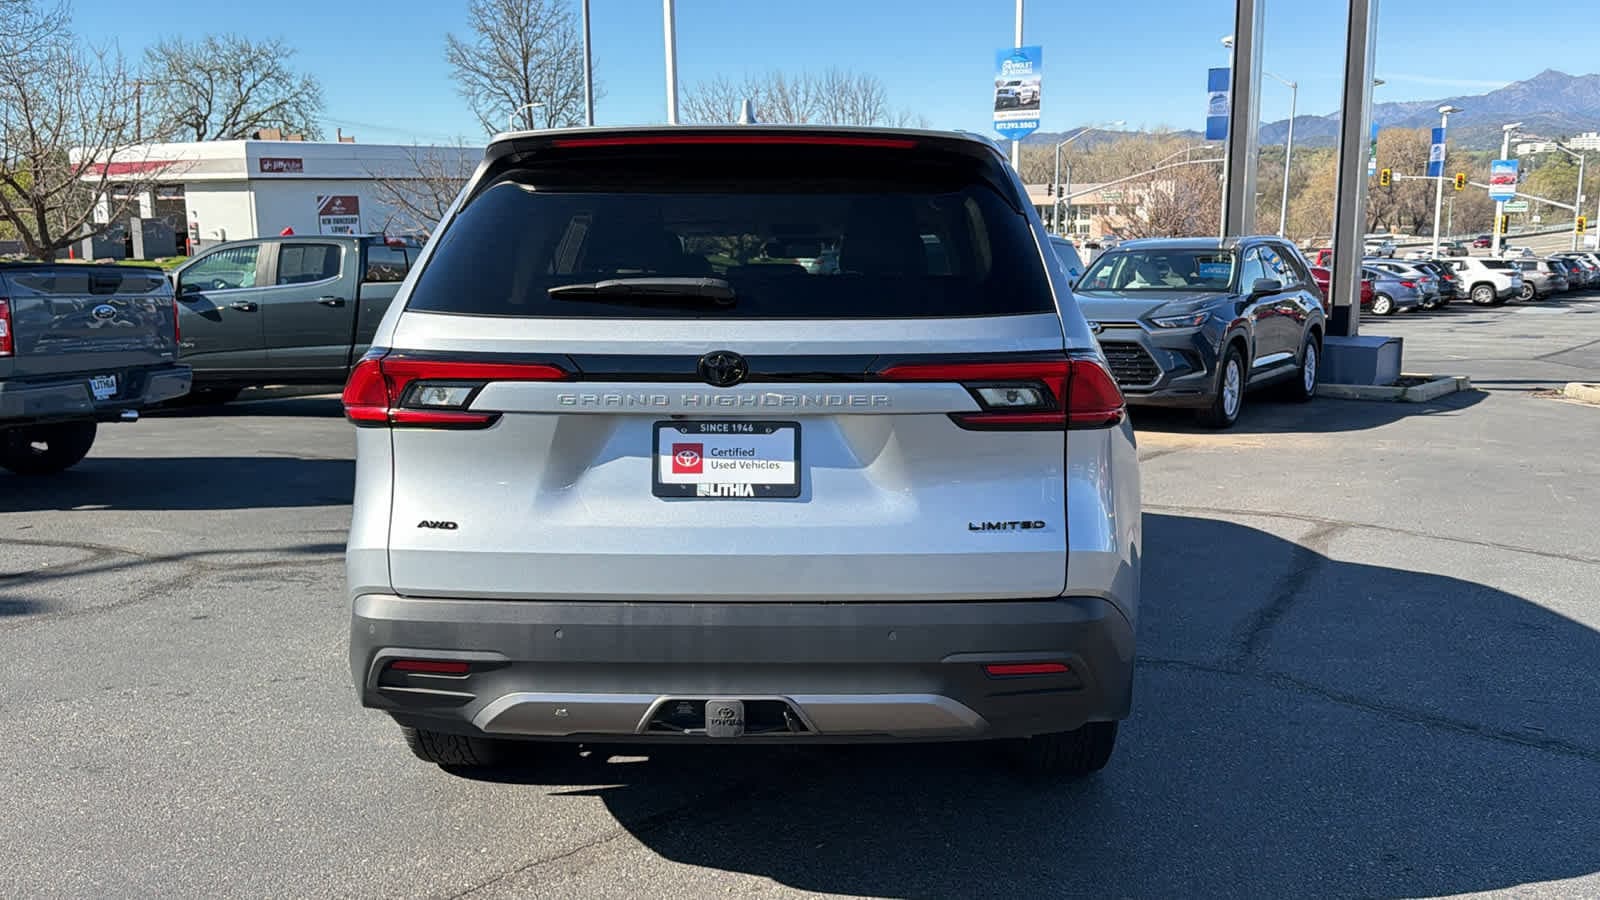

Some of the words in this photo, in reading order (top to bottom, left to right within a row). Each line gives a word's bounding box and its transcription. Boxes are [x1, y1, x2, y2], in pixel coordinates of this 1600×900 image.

[557, 393, 670, 407] GRAND
[681, 392, 892, 408] HIGHLANDER
[700, 424, 729, 432] SINCE
[732, 423, 754, 432] 1946
[711, 447, 755, 457] Certified
[711, 461, 737, 470] Used
[739, 461, 780, 470] Vehicles
[709, 483, 755, 497] LITHIA
[416, 520, 459, 530] AWD
[968, 520, 1046, 531] LIMITED
